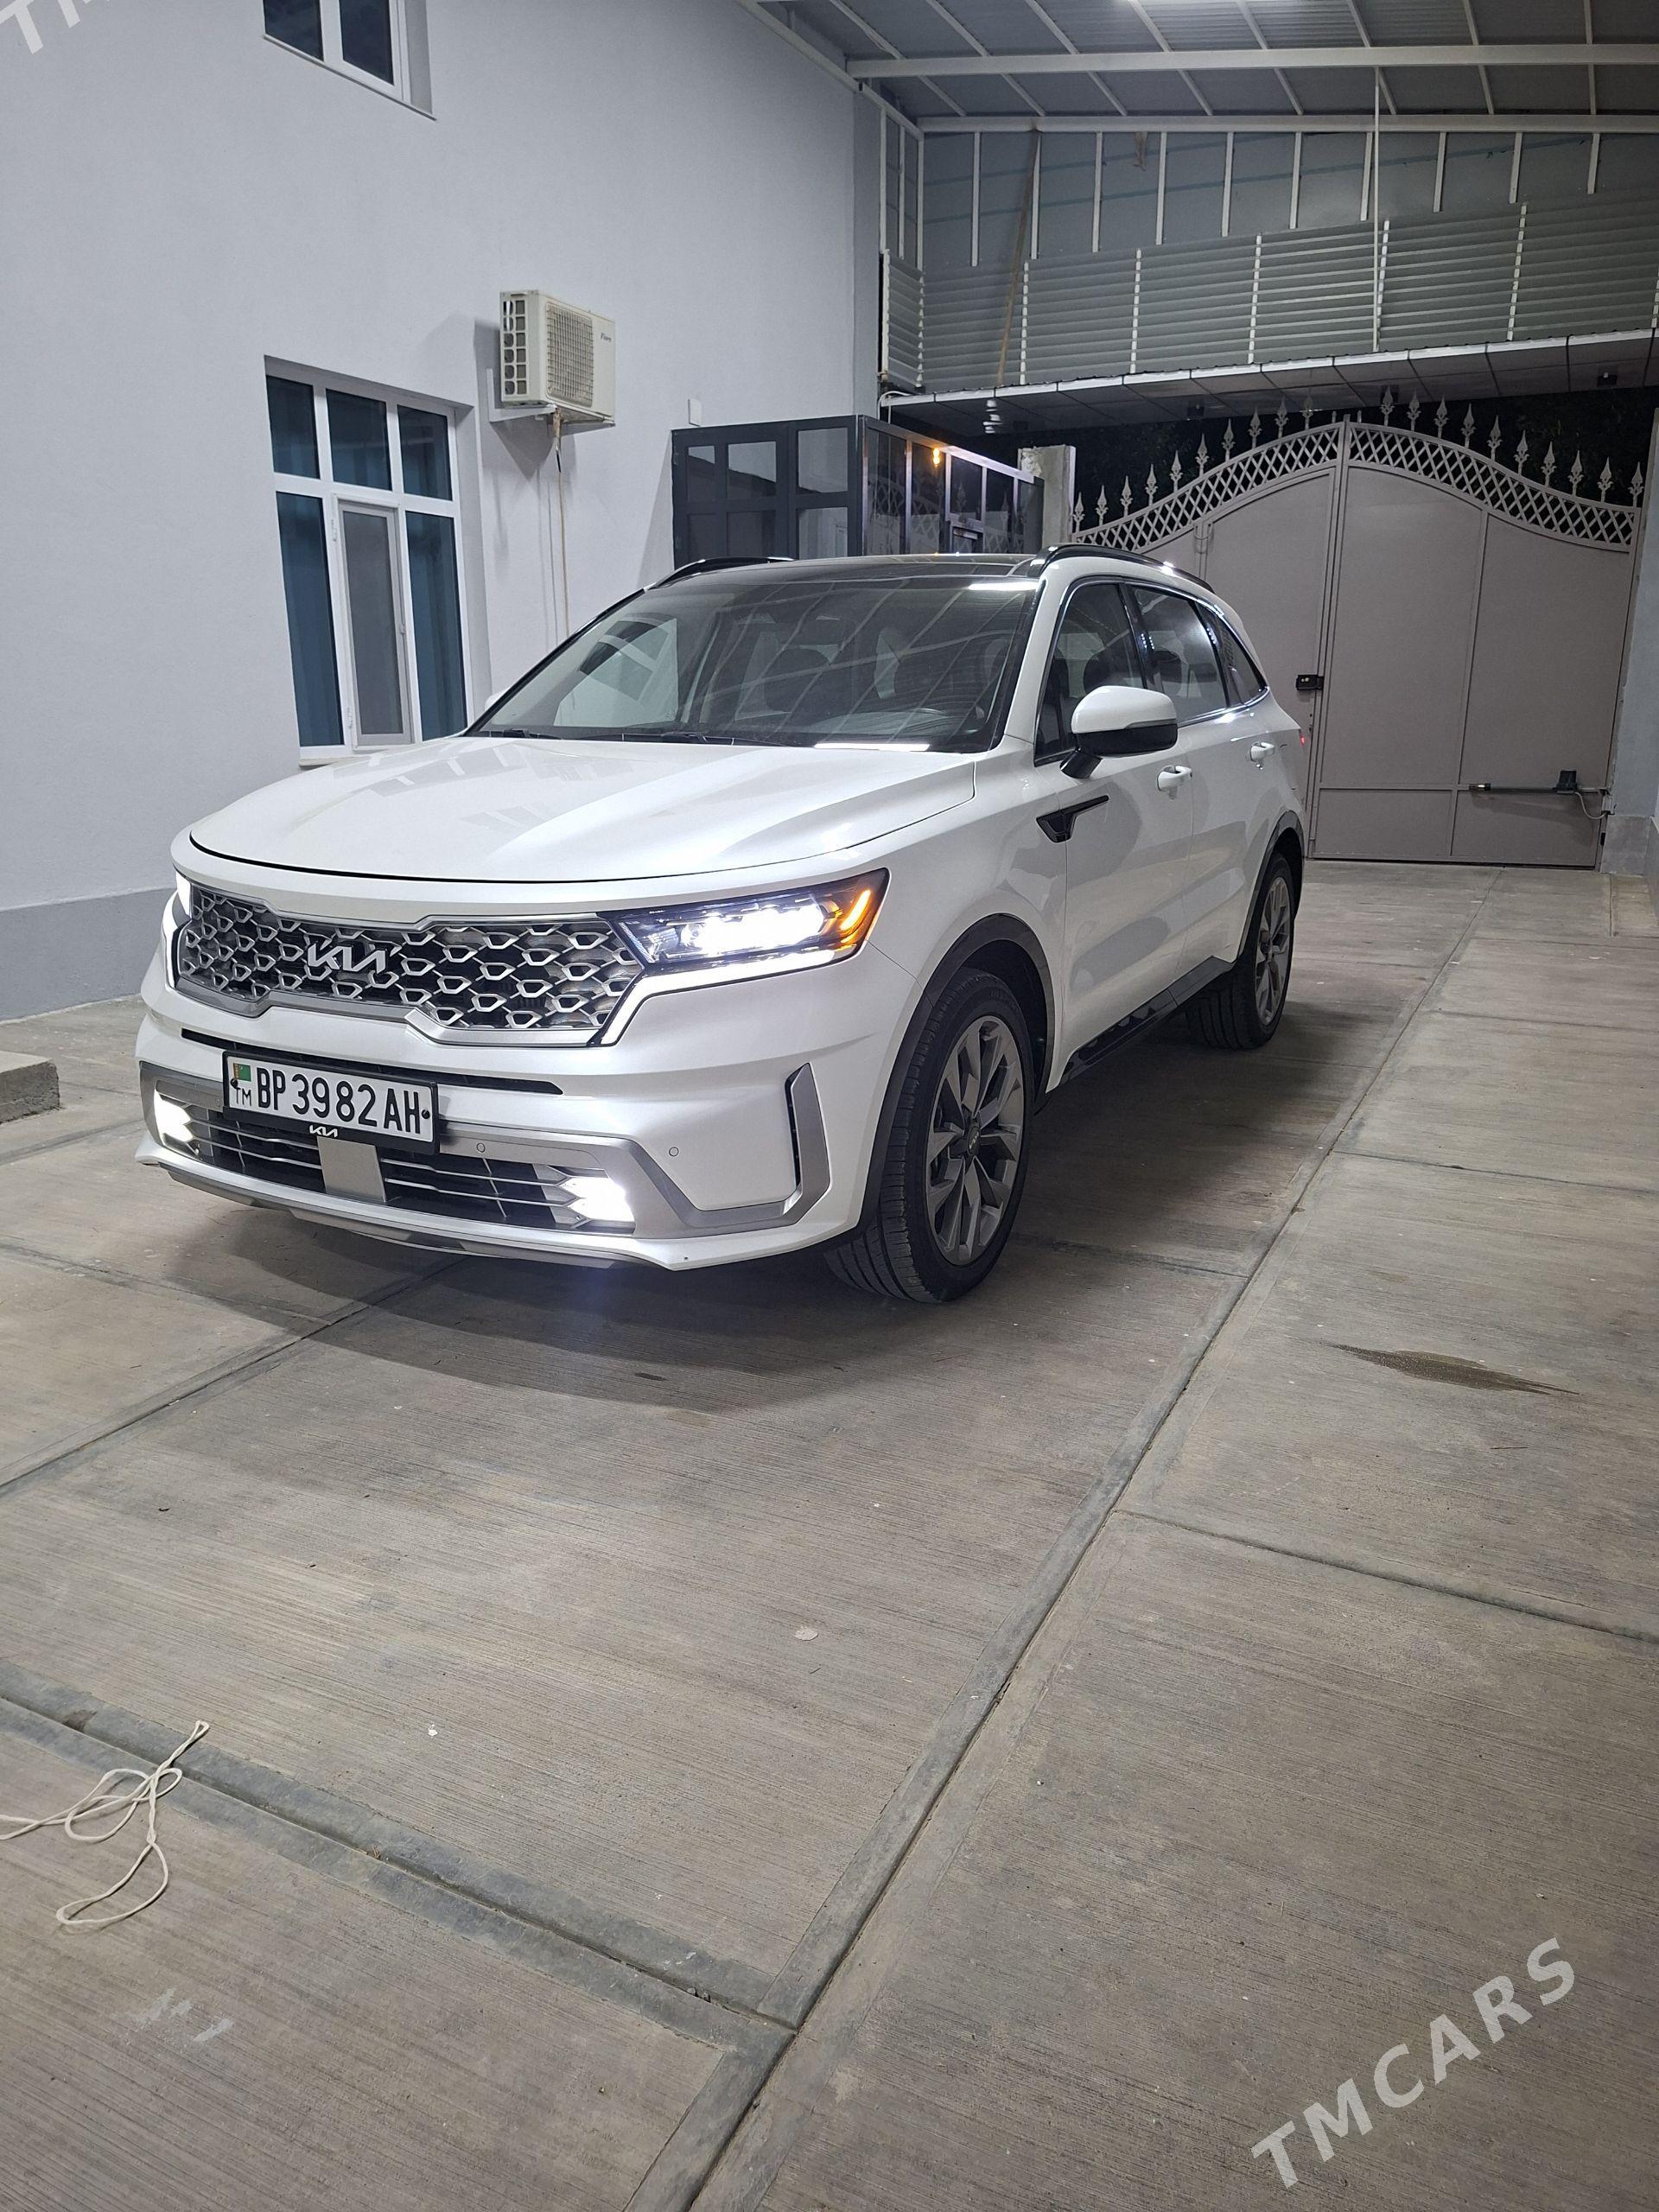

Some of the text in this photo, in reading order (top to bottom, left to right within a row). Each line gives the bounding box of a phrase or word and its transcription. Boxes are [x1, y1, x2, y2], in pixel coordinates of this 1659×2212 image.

[308, 943, 385, 974] KIA
[234, 1086, 252, 1106] TM
[309, 1124, 338, 1138] KIA
